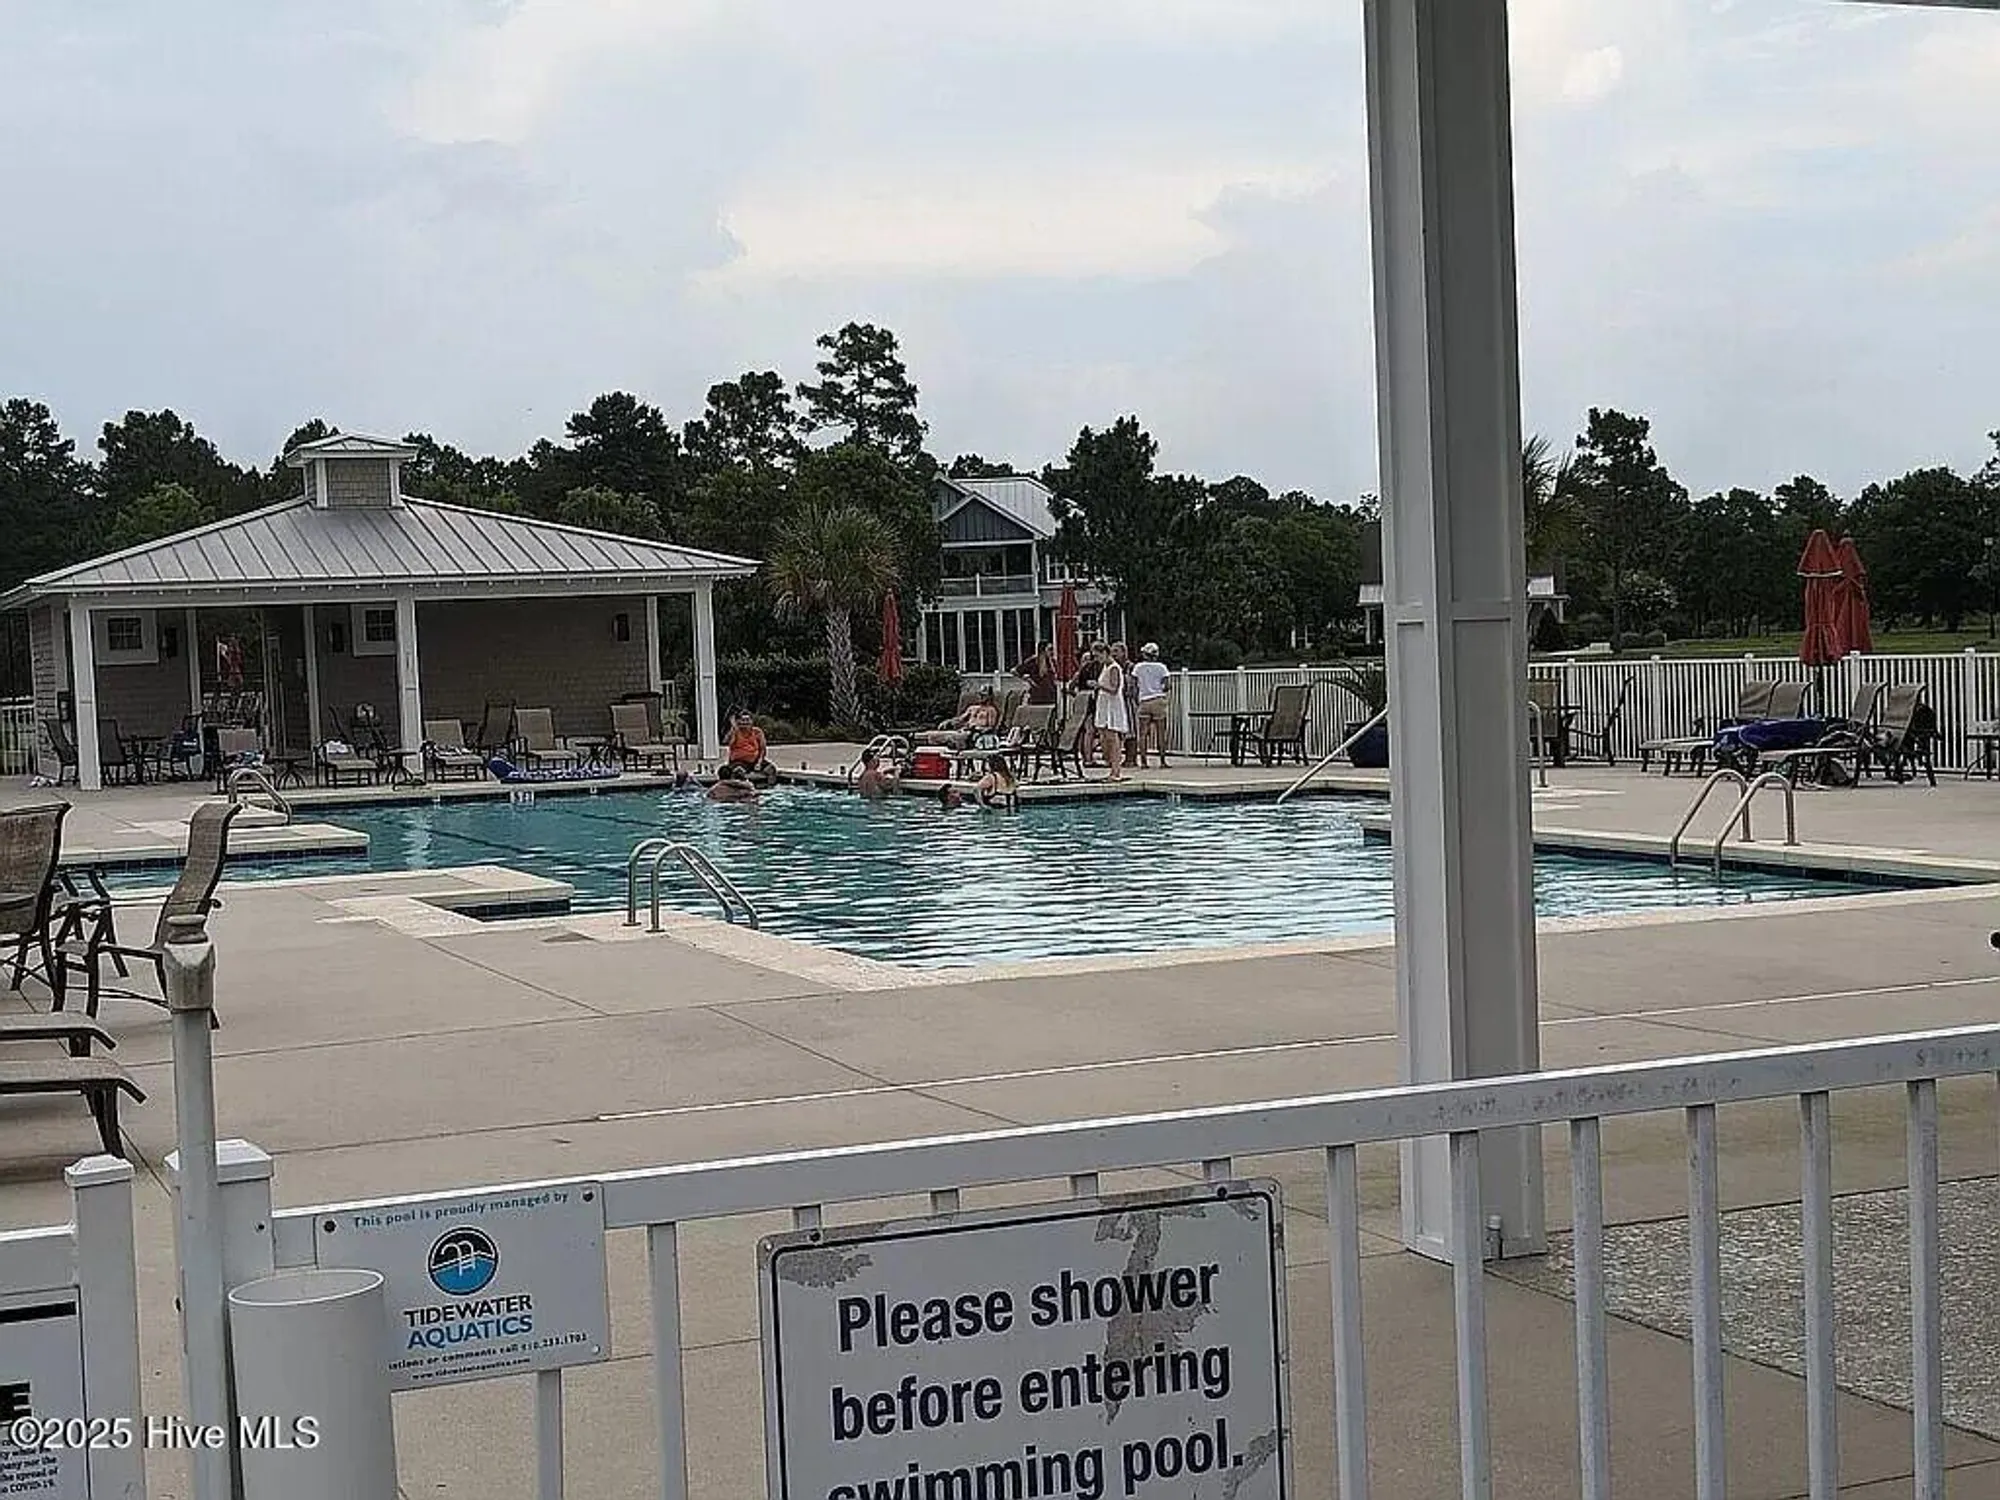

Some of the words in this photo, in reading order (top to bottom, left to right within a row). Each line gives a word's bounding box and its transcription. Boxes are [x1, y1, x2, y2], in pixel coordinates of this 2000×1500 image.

[354, 1214, 381, 1228] This
[386, 1210, 416, 1226] pool
[420, 1209, 431, 1220] is
[435, 1201, 486, 1220] proudly
[490, 1194, 550, 1211] managed
[554, 1191, 569, 1204] by
[403, 1295, 533, 1328] TIDEWATER
[407, 1315, 533, 1350] AQUATICS
[838, 1288, 1013, 1353] Please
[1030, 1262, 1220, 1328] shower
[831, 1374, 1003, 1441] before
[1019, 1341, 1231, 1413] entering
[827, 1445, 1104, 1500] imming
[1123, 1417, 1244, 1495] pool.
